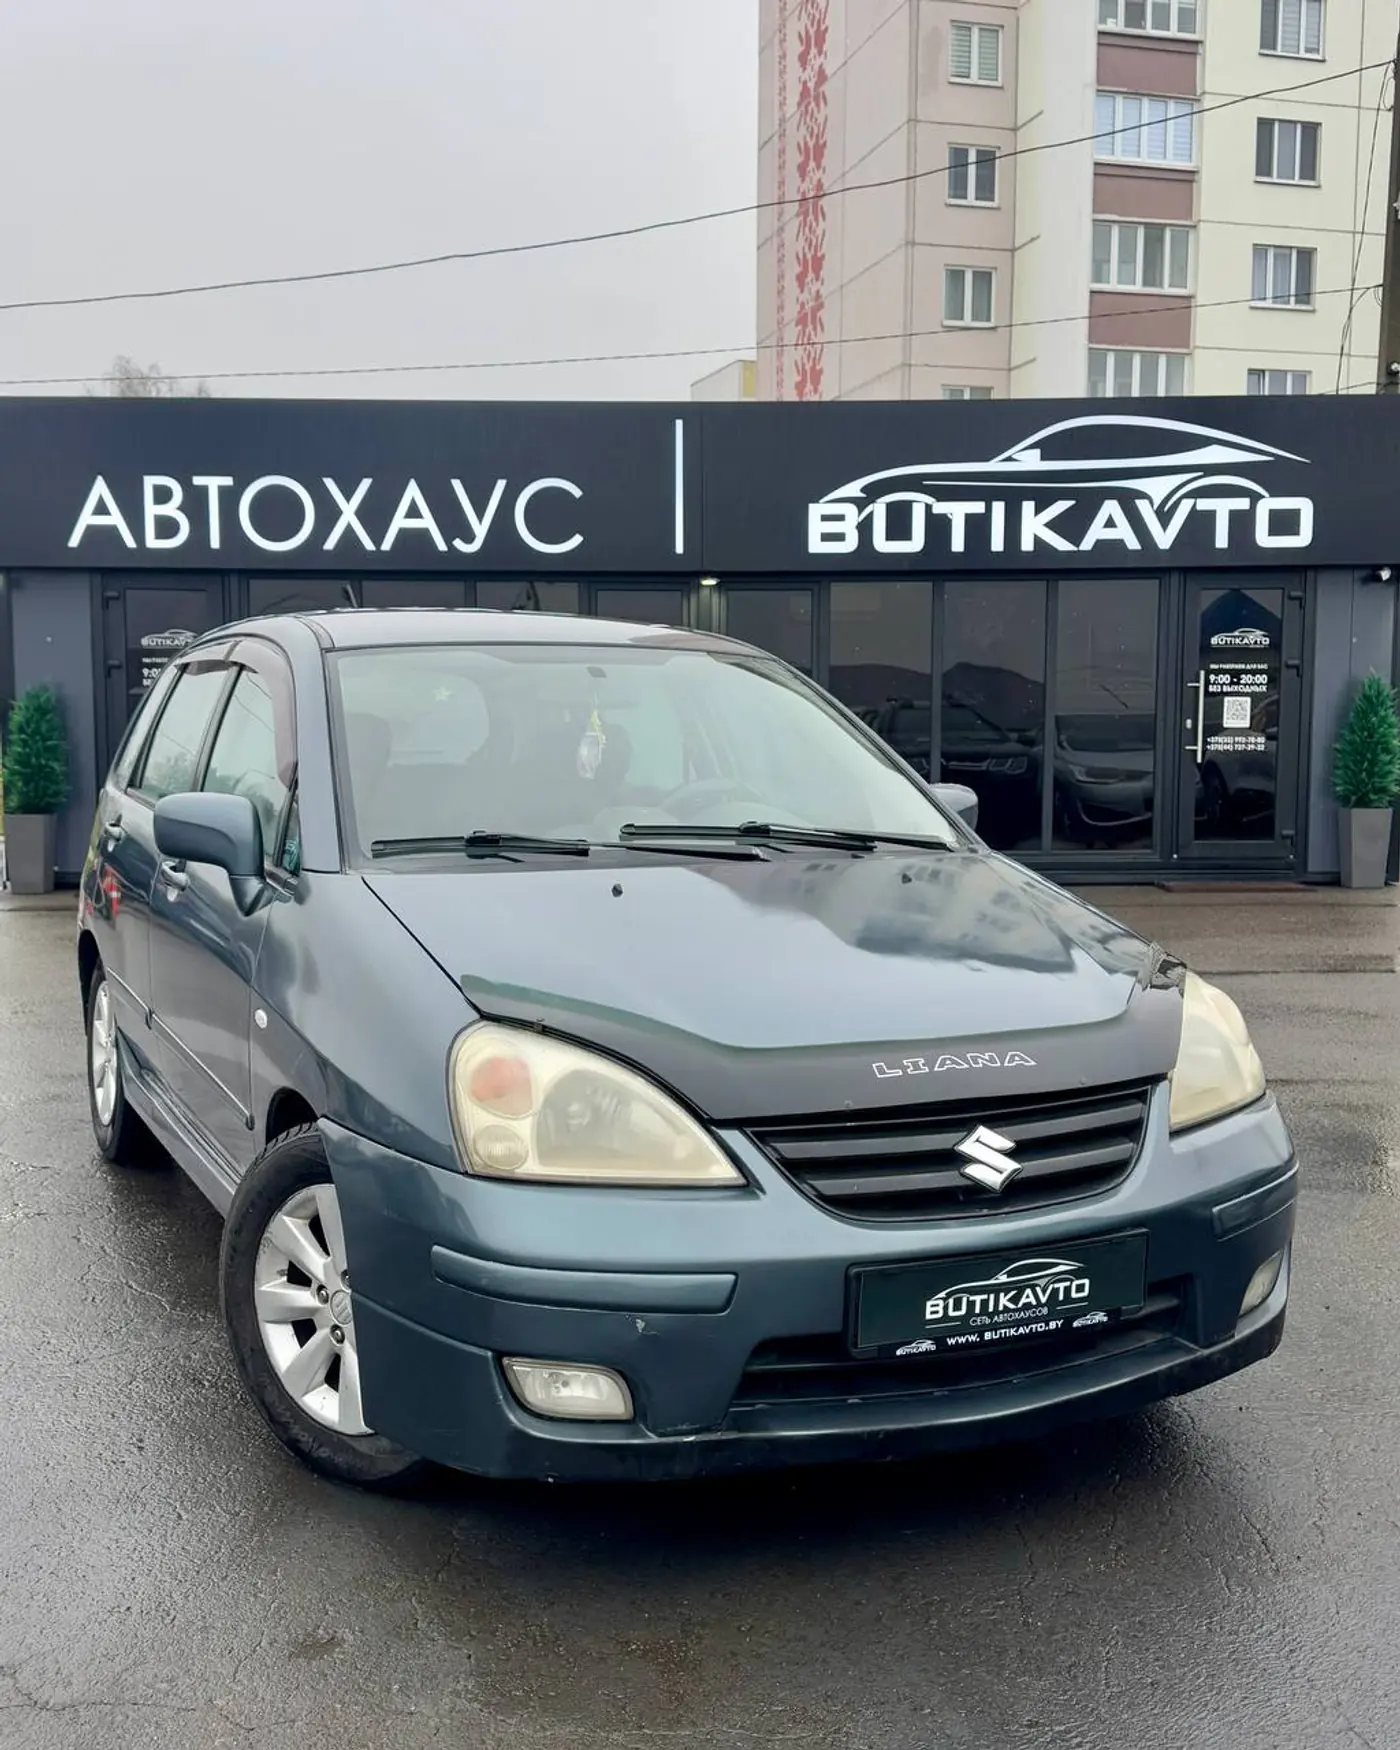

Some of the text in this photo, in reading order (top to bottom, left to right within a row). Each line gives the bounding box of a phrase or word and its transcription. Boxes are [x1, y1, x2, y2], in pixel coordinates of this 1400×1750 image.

[67, 474, 585, 555] АВТОХАУС
[807, 496, 1314, 555] BUTIKAVTO
[1210, 637, 1270, 645] BUTIKAVTO
[1209, 673, 1231, 684] 9:00
[1239, 673, 1268, 684] 20:00
[1222, 684, 1268, 693] ВЫХОДНЫХ
[872, 1051, 1038, 1078] LIANA
[925, 1277, 1090, 1320] BUTIKAVTO
[970, 1306, 1049, 1327] СЕТЬ АВТОХАУСОВ
[946, 1319, 1064, 1346] WWW. BUTIKAVTO.BY
[895, 1344, 937, 1356] BUTIKAVTO
